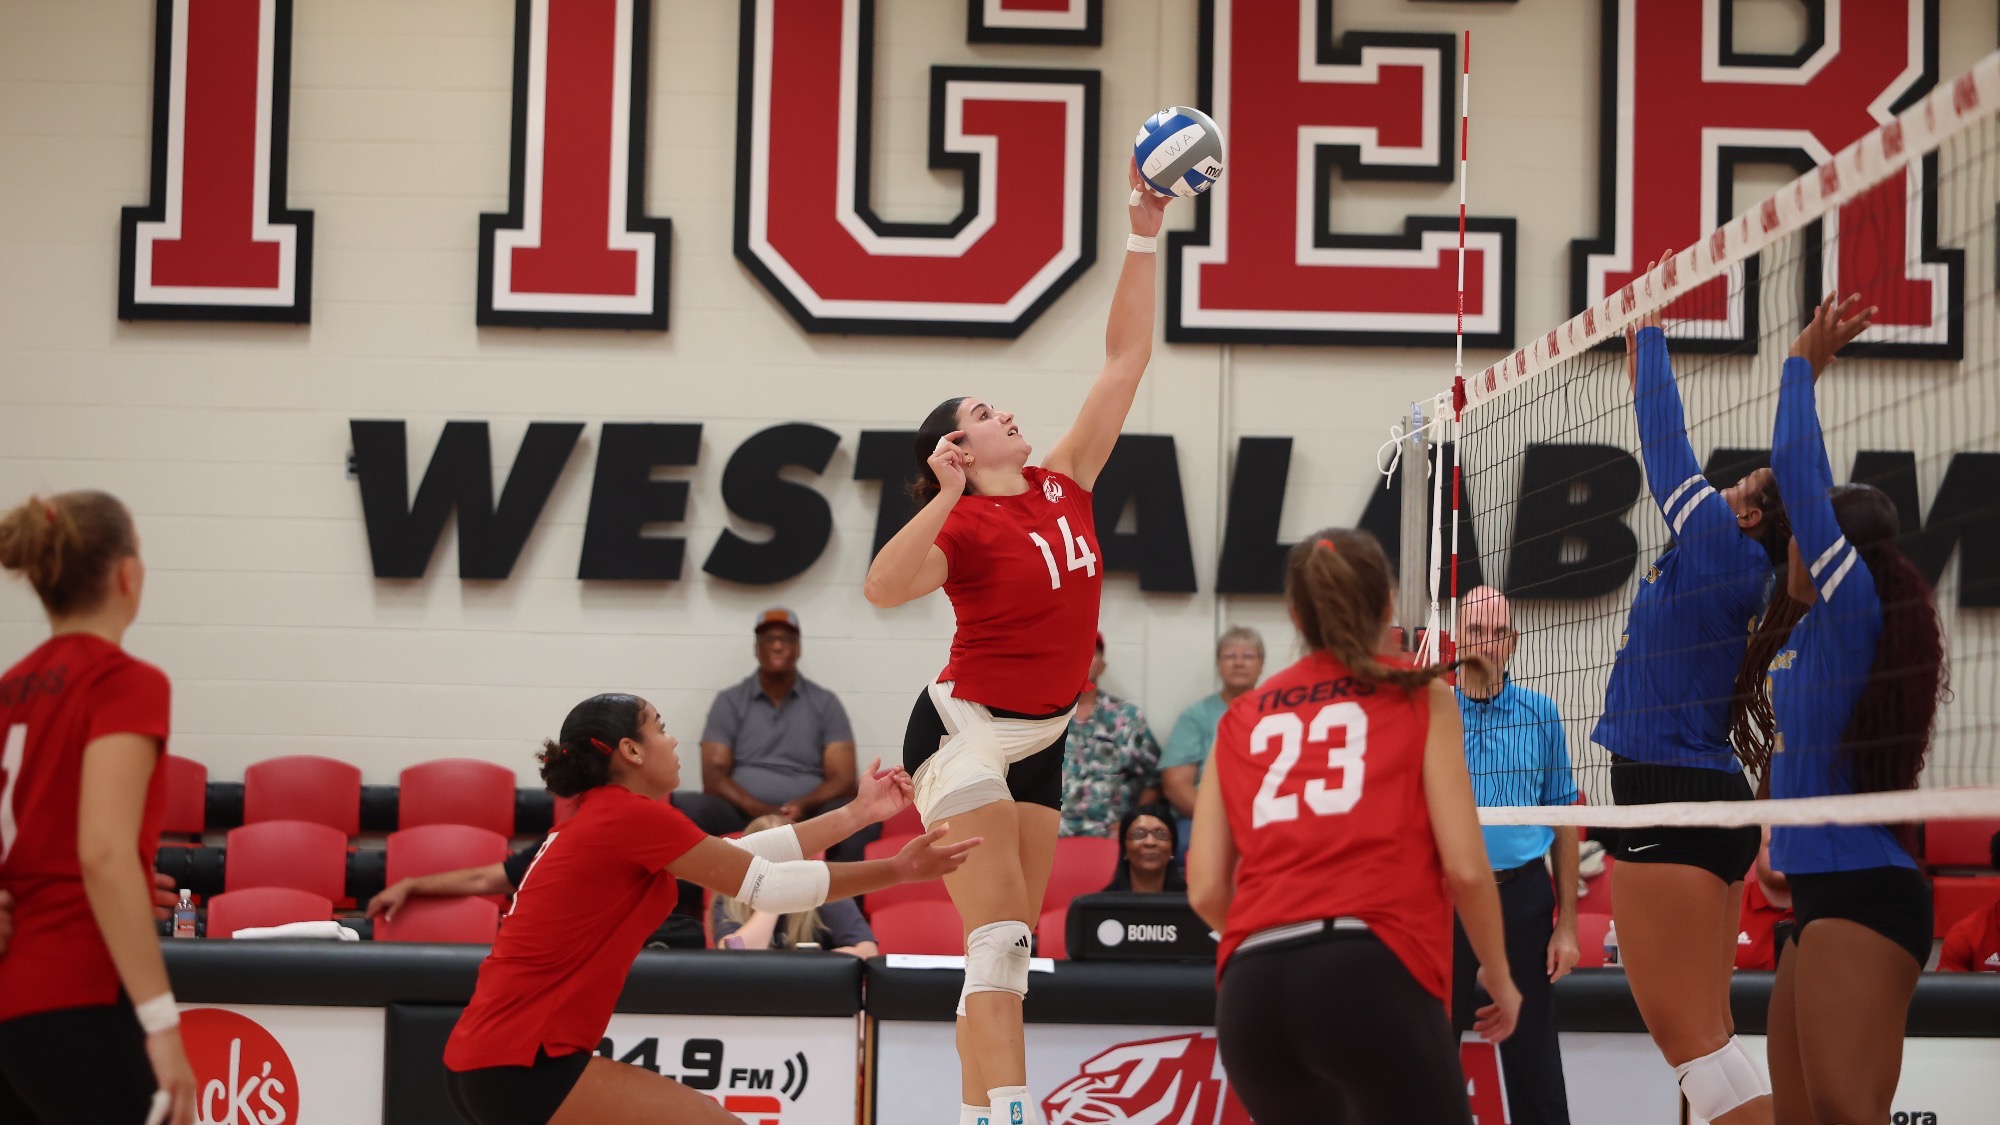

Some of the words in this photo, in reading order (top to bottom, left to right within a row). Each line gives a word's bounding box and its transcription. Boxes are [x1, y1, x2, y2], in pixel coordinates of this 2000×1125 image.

[349, 418, 920, 586] WEST
[1028, 515, 1097, 591] 14
[1257, 676, 1377, 712] TIGERS
[1250, 701, 1369, 830] 23
[1127, 924, 1178, 942] BONUS
[196, 1037, 288, 1125] ck's
[593, 1036, 724, 1091] 4.9
[728, 1068, 774, 1090] FM
[1888, 1110, 1937, 1125] ora
